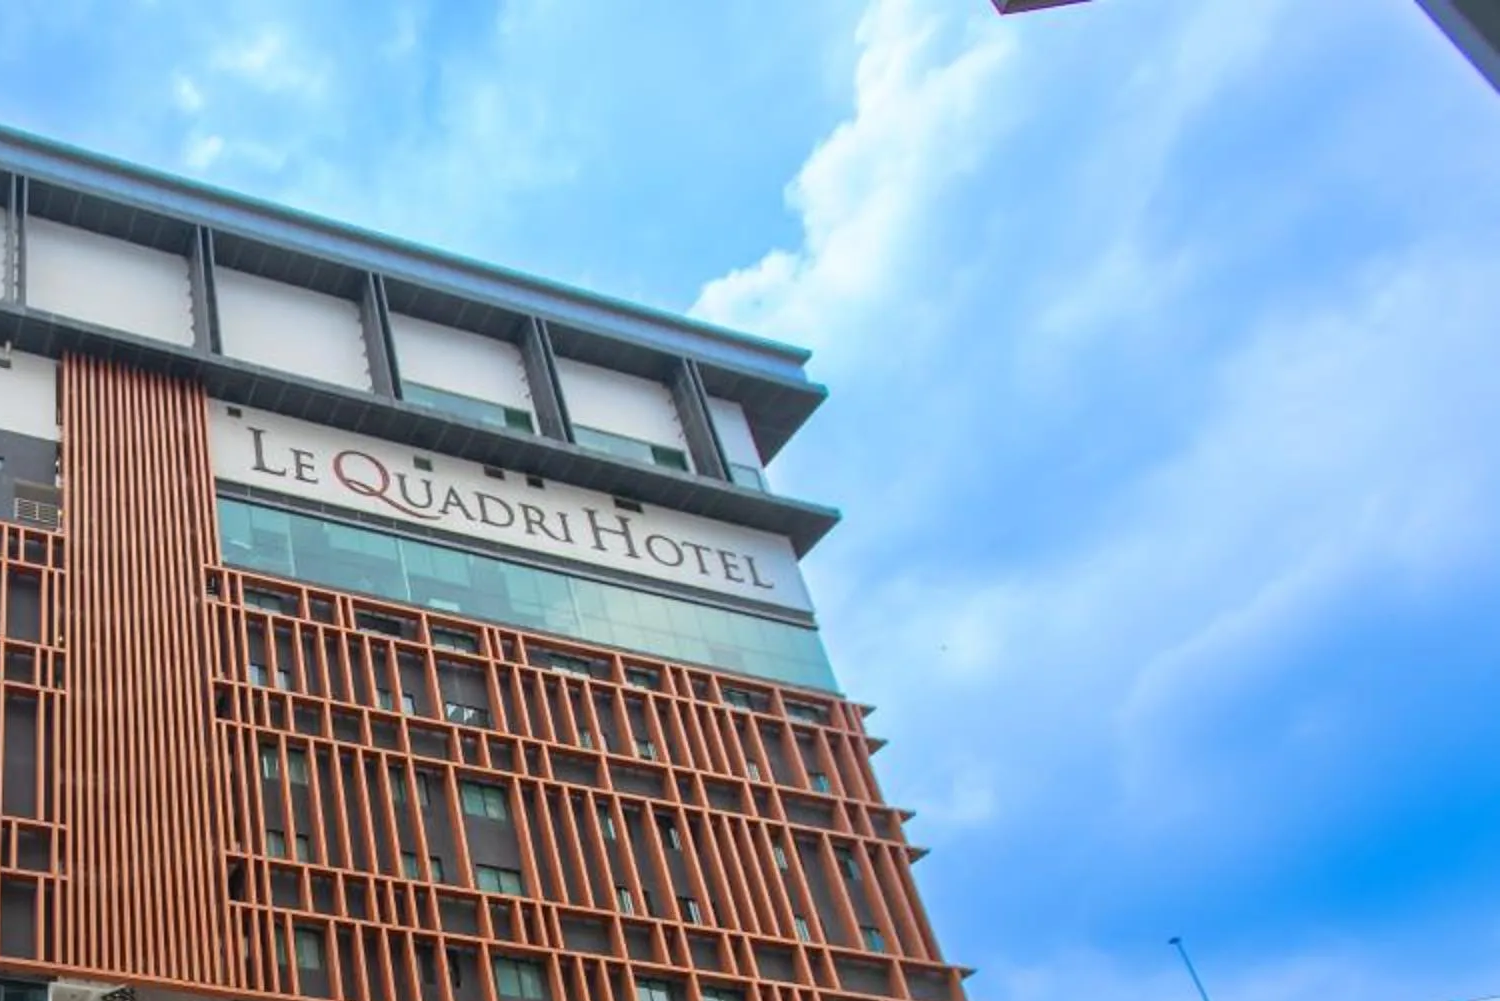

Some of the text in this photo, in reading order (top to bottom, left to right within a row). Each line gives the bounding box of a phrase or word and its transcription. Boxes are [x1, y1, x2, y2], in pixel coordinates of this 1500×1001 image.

[247, 427, 774, 590] LE QUADRI HOTEL
